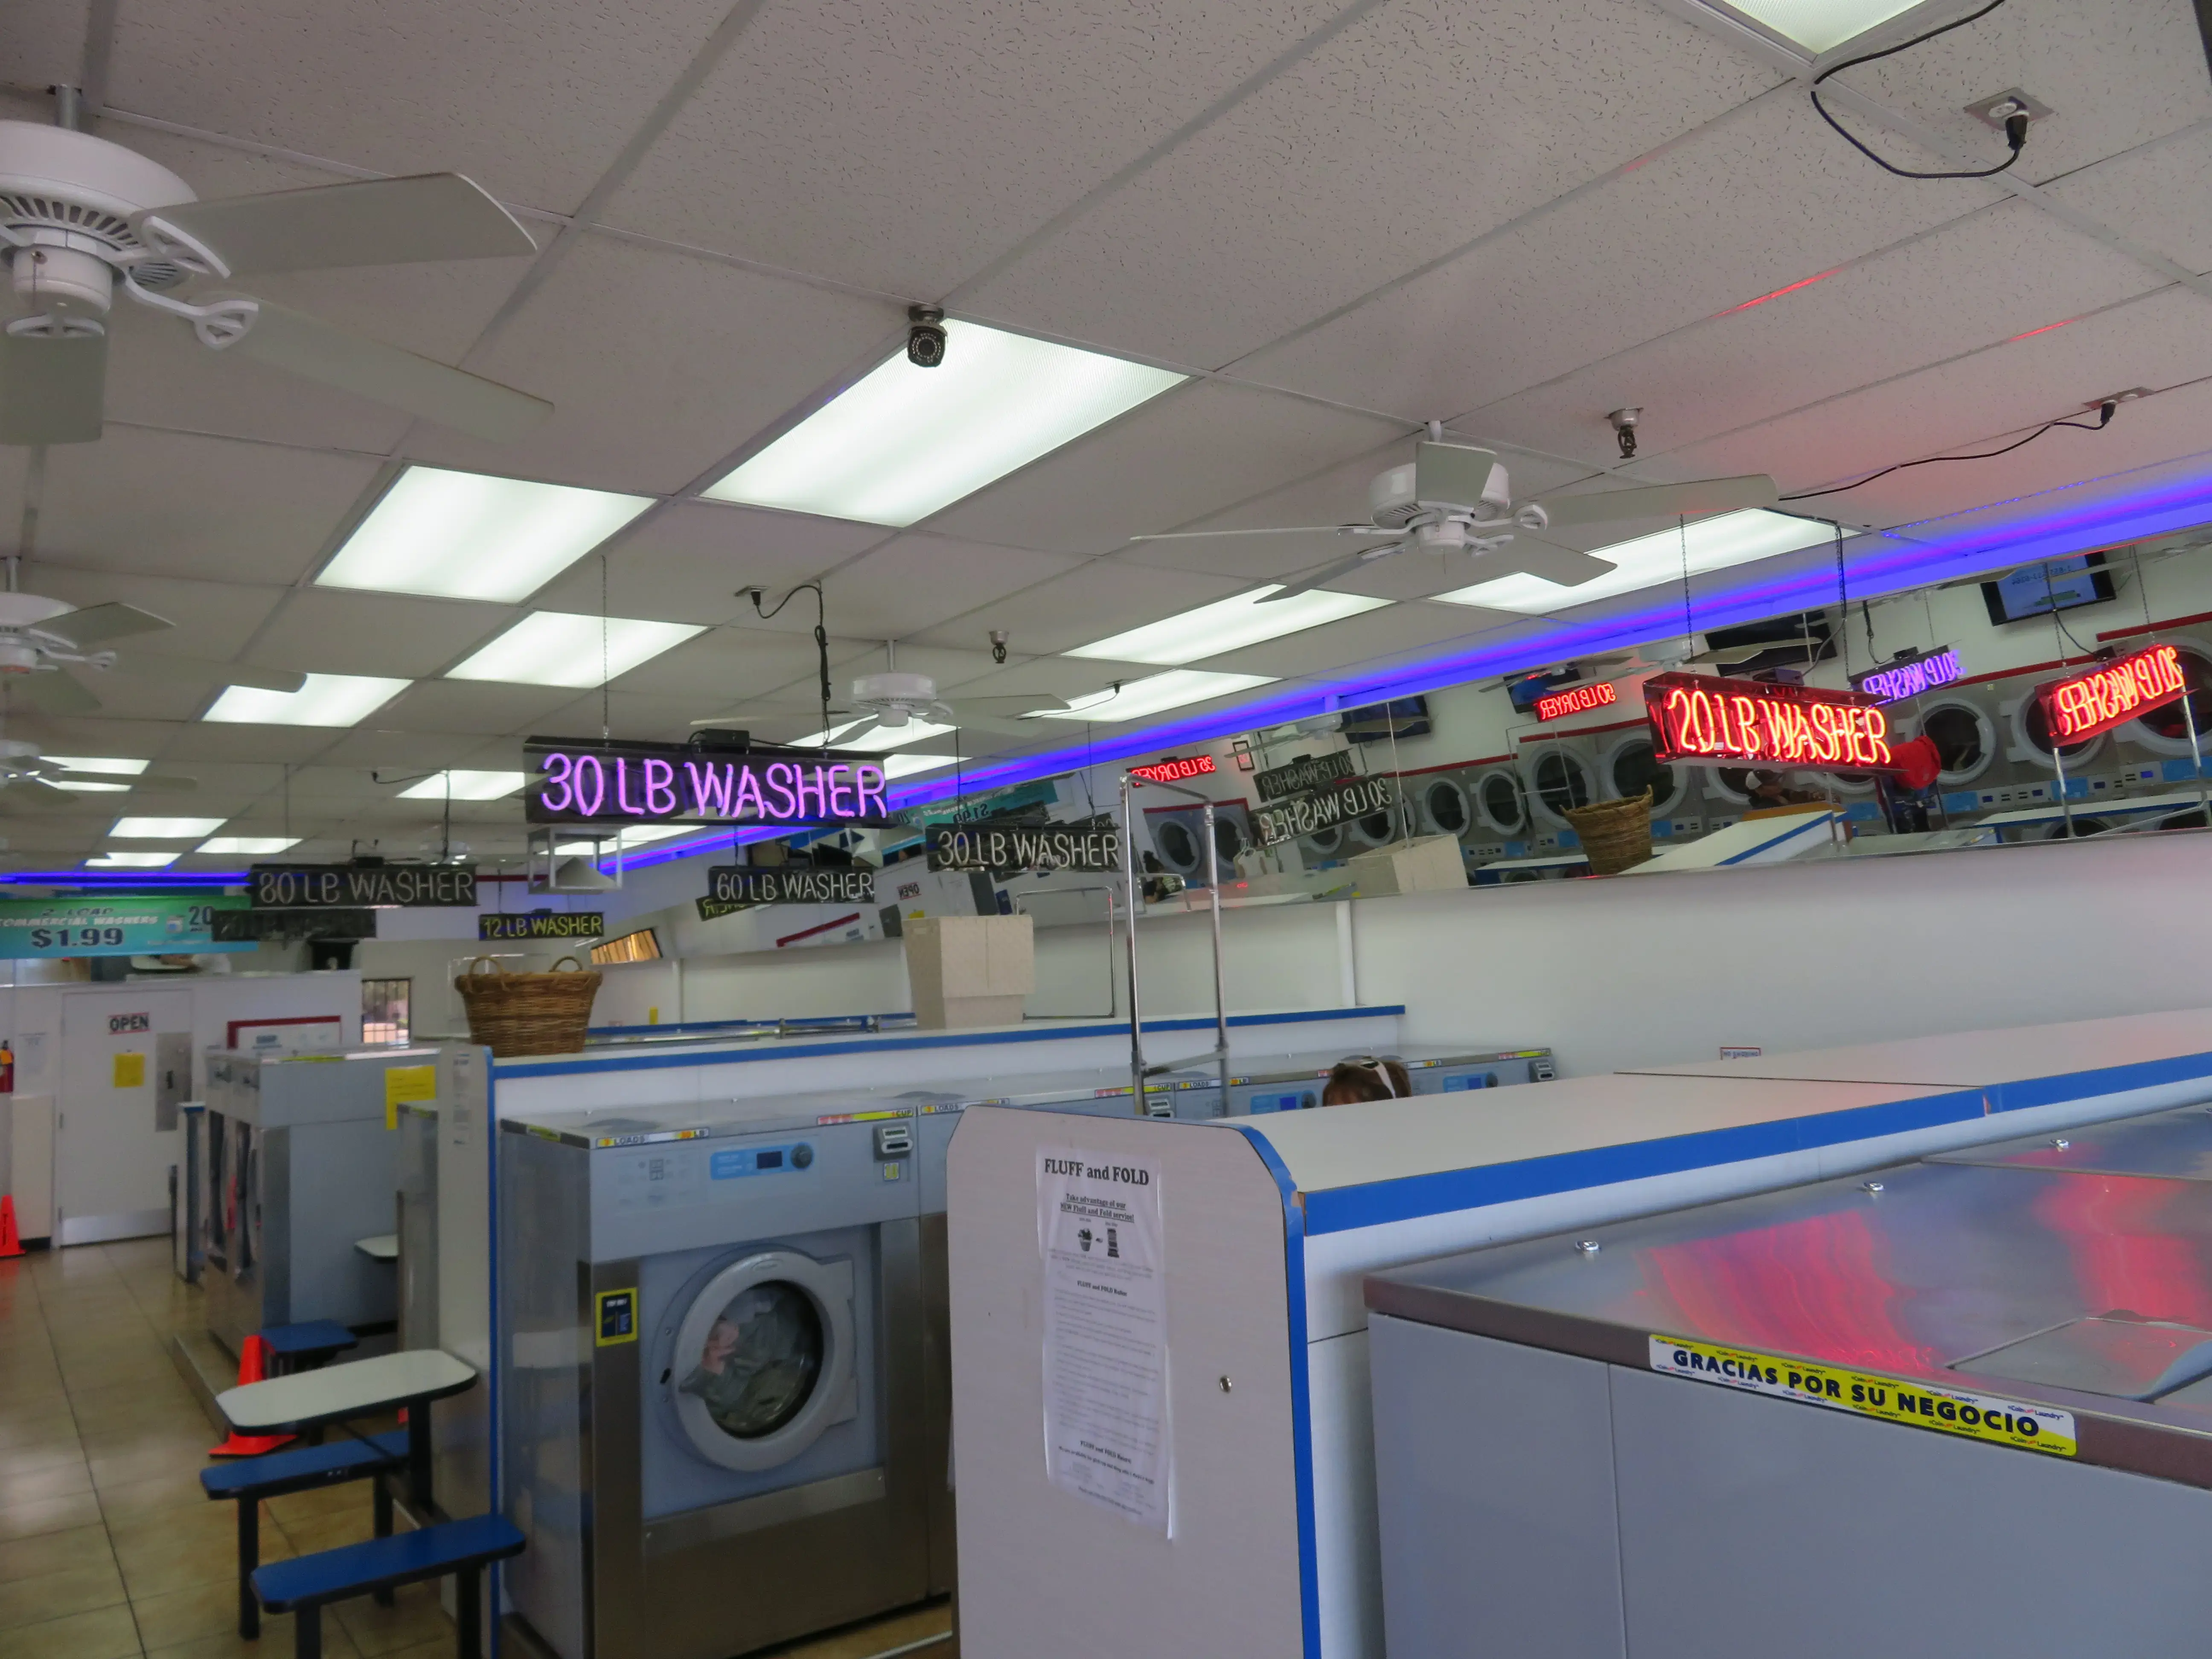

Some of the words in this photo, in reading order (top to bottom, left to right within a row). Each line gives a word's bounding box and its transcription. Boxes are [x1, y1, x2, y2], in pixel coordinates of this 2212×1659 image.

[1668, 690, 1715, 753] 20
[1714, 694, 1761, 753] LB
[1757, 700, 1891, 764] WASHER
[541, 753, 604, 816] 30
[616, 757, 676, 815] LB
[684, 762, 888, 818] WASHER
[938, 831, 969, 866] 30
[975, 832, 1006, 866] LB
[1012, 833, 1119, 867] WASHER
[259, 873, 294, 903] 80
[304, 873, 340, 903] LB
[346, 870, 474, 902] WASHER
[717, 873, 742, 900] 60
[750, 874, 777, 900] LB
[782, 873, 874, 899] WASHER
[189, 906, 214, 925] 20
[484, 918, 502, 937] 12
[506, 918, 527, 937] LB
[531, 916, 602, 935] WASHER
[31, 928, 123, 948] $1.99
[110, 1015, 149, 1032] OPEN
[1045, 1158, 1084, 1177] FLUFF
[1087, 1166, 1109, 1180] and
[1112, 1166, 1149, 1186] FOLD
[1080, 1196, 1108, 1206] advantage
[1100, 1209, 1112, 1217] Fold
[1674, 1350, 1778, 1385] GRACIAS
[1788, 1372, 1841, 1398] POR
[1852, 1385, 1885, 1406] SU
[1898, 1394, 2039, 1436] NEGOCIO
